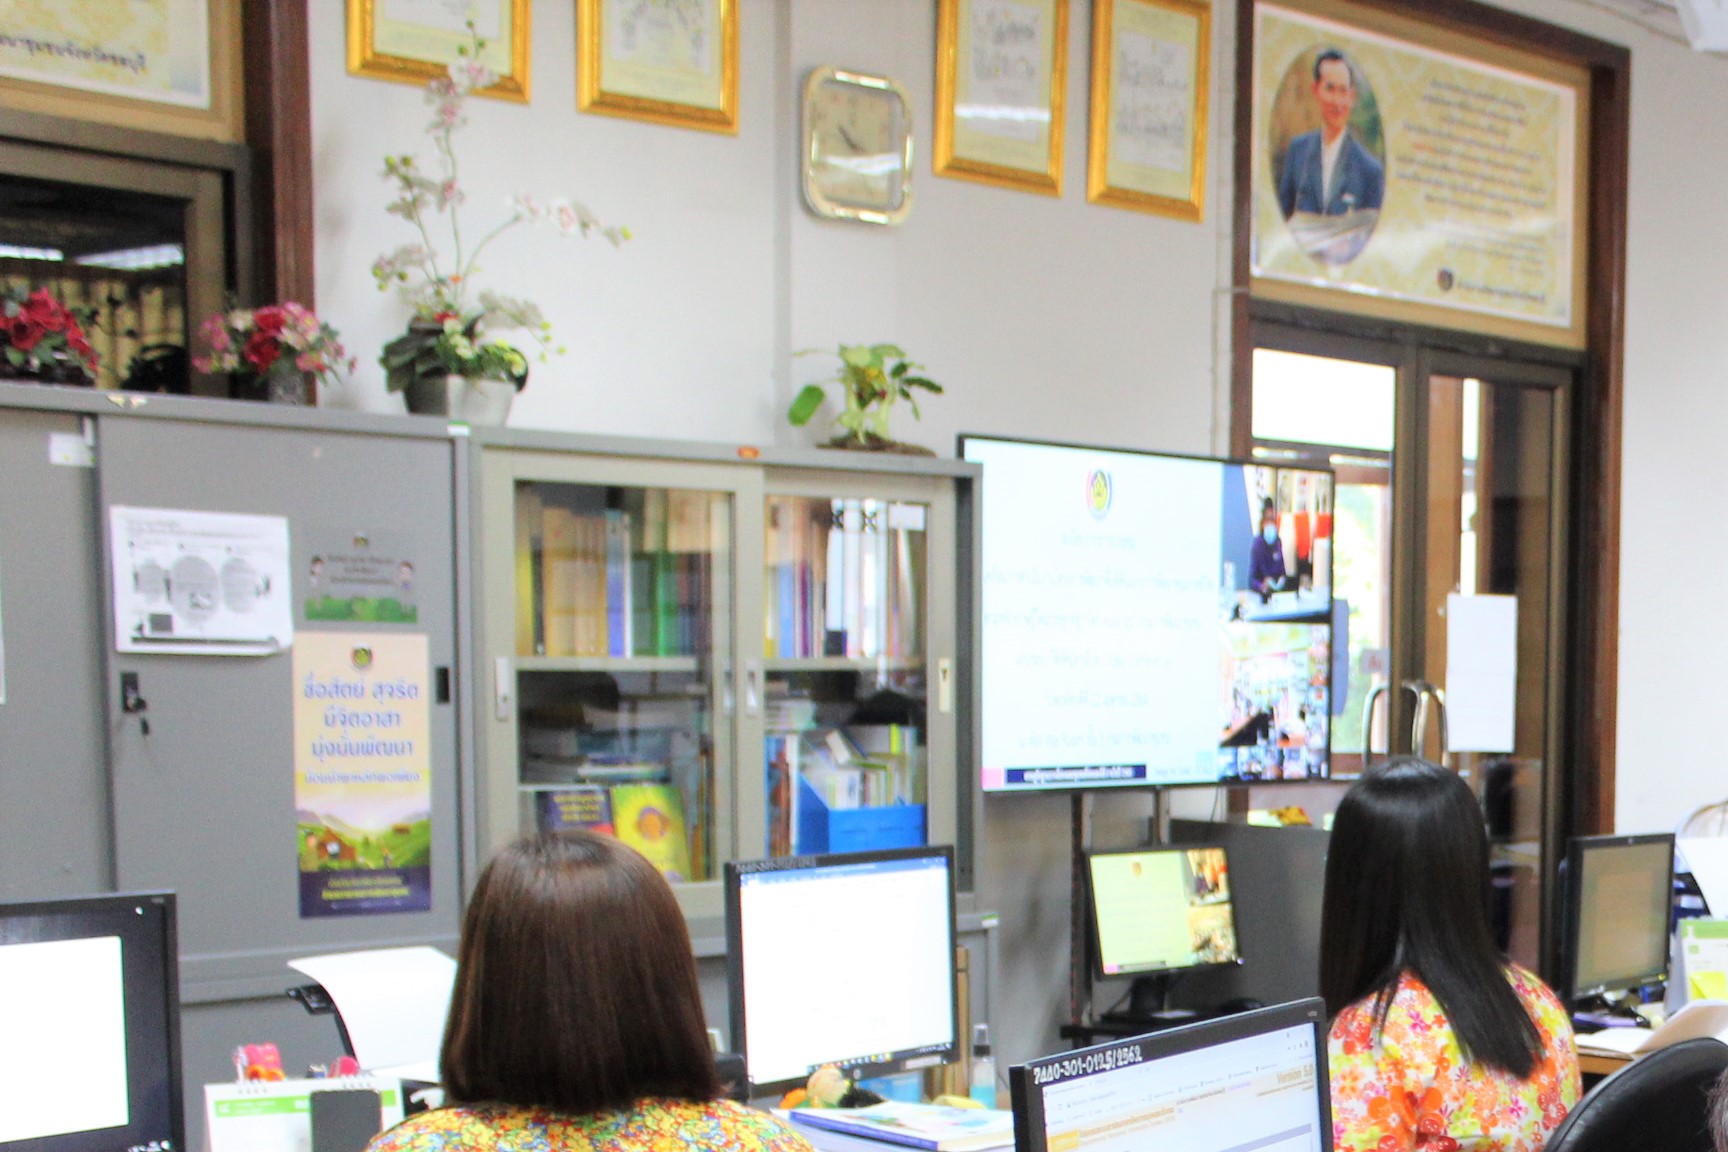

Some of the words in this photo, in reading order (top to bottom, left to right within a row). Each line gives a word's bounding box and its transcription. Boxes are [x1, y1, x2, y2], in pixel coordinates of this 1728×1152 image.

[372, 679, 418, 705] สุจริต
[324, 704, 401, 728] มีจิตอาสา
[311, 729, 413, 763] มุ่งมั่นพัฒนา
